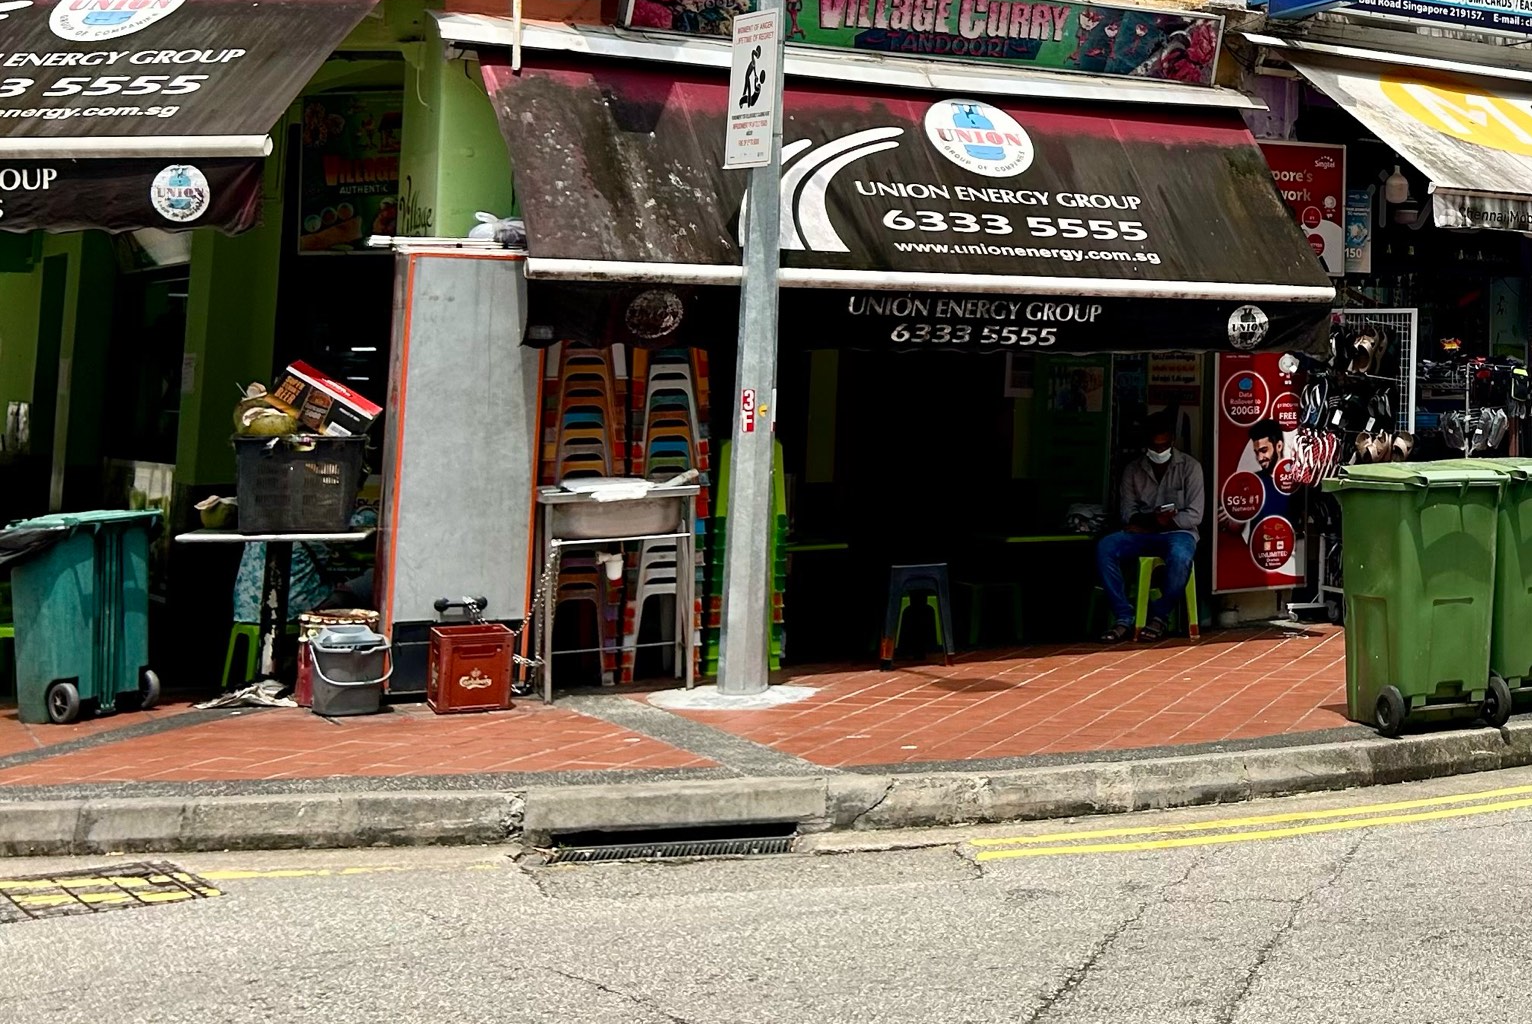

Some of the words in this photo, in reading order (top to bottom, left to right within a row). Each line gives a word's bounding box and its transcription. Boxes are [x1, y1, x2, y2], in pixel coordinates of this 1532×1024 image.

[1402, 1, 1448, 16] Singapore
[887, 31, 1009, 58] TANDOORI
[3, 50, 130, 67] ENERGY
[129, 48, 246, 65] GROUP
[42, 74, 209, 97] 5555
[935, 127, 1023, 147] UNION
[944, 145, 972, 165] GROUP
[978, 163, 988, 171] OF
[1314, 159, 1336, 169] Singtel
[854, 179, 950, 200] UNION
[955, 185, 1049, 206] ENERGY
[1056, 192, 1142, 210] GROUP
[882, 209, 1013, 235] 6333
[1026, 216, 1148, 241] 5555
[893, 240, 1162, 265] www.unionenergy.com.sg
[848, 295, 930, 318] UNION
[935, 298, 1023, 321] ENERGY
[1025, 301, 1103, 323] GROUP
[890, 322, 972, 344] 6333
[980, 325, 1058, 347] 5555
[1231, 323, 1267, 334] UNION
[1231, 405, 1260, 415] 200GB
[1278, 411, 1297, 420] FREE
[1227, 496, 1247, 505] SG's
[1258, 550, 1288, 559] UNLIMITED
